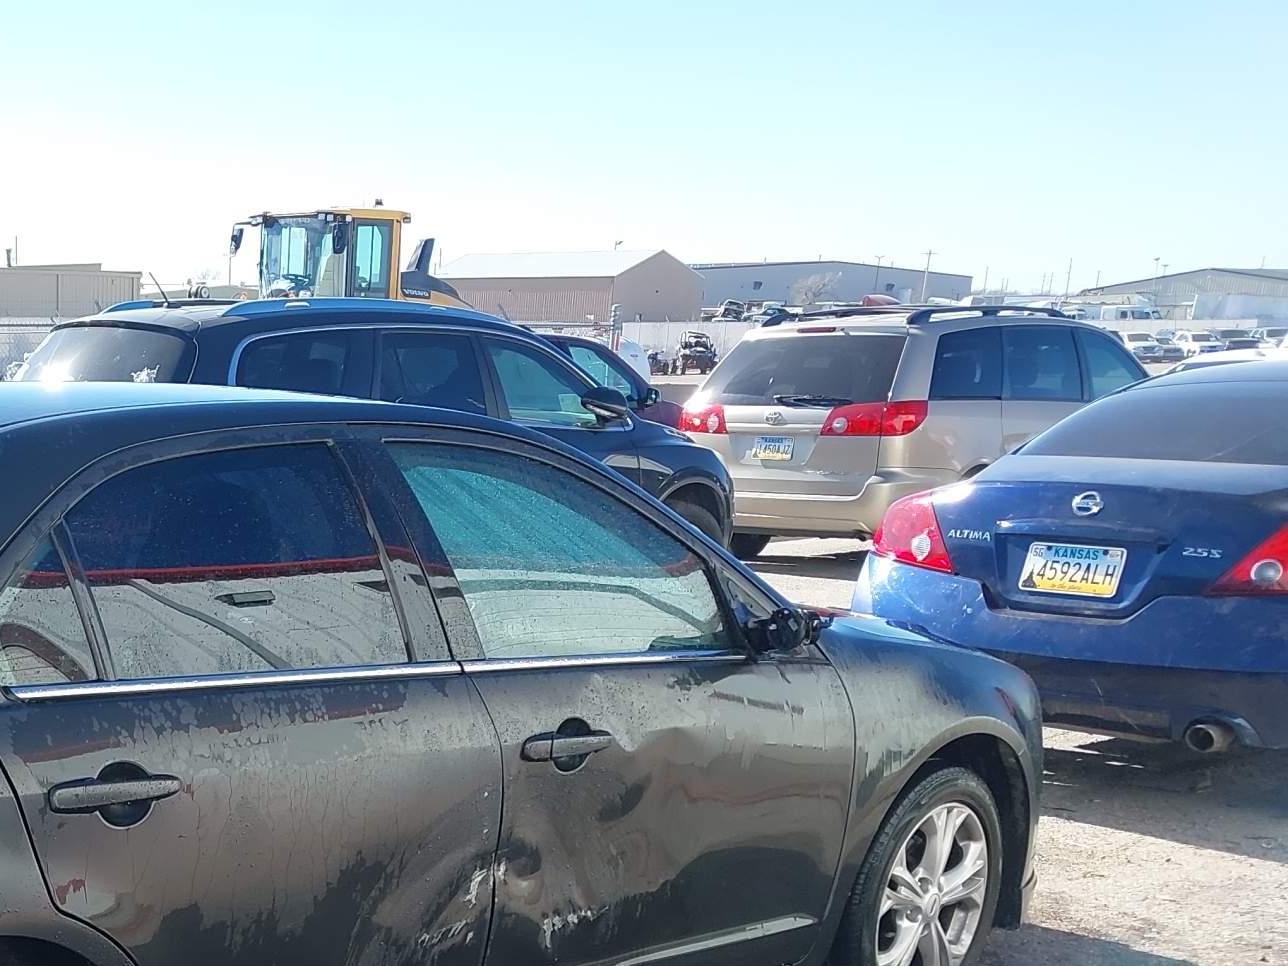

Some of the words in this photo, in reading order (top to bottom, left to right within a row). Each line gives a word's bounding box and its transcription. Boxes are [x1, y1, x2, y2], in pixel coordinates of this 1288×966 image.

[947, 529, 991, 542] ALTIMA
[1053, 547, 1100, 561] KANSAS
[1036, 560, 1117, 586] 4592ALH
